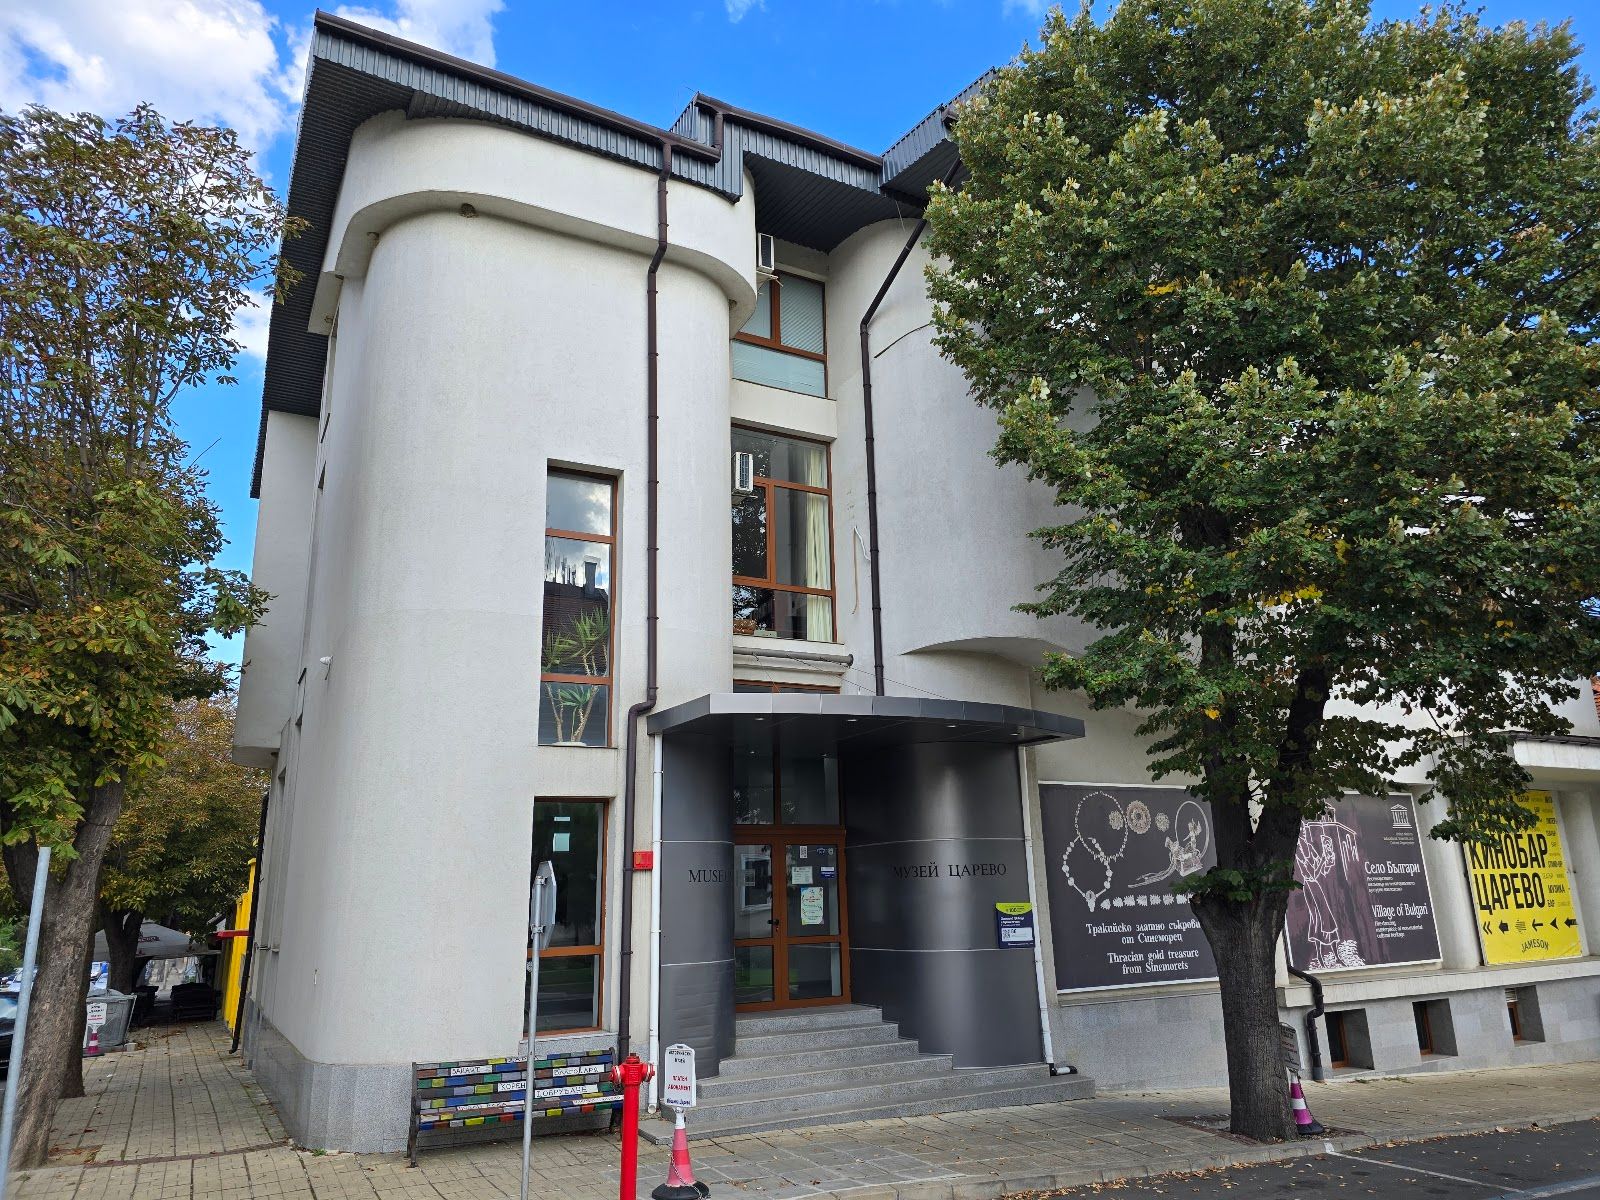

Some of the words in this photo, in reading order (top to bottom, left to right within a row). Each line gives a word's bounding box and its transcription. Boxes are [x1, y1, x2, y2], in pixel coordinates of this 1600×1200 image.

[1468, 833, 1548, 870] КИНОБАР
[893, 862, 939, 879] МУЗЕЙ
[948, 863, 1007, 879] ЦАРЕВО
[1364, 861, 1386, 874] Село
[1386, 861, 1421, 877] Българи
[1474, 872, 1546, 915] ЦАРЕВО
[1372, 904, 1396, 920] Village
[1396, 903, 1404, 916] of
[1404, 902, 1429, 919] Bulgari
[1086, 922, 1132, 936] Тракийско
[1136, 922, 1165, 932] златно
[1168, 918, 1201, 932] съкрови
[1121, 935, 1135, 945] от
[1138, 932, 1183, 945] Синеморец
[1521, 938, 1549, 953] JAMESON
[1107, 951, 1144, 964] Thracian
[1147, 949, 1165, 962] gold
[1168, 948, 1199, 959] treasure
[1122, 964, 1142, 974] from
[1145, 960, 1189, 973] Sinemorets
[501, 1082, 526, 1091] КОРЕН
[668, 1084, 691, 1092] АБОНАМЕНТ
